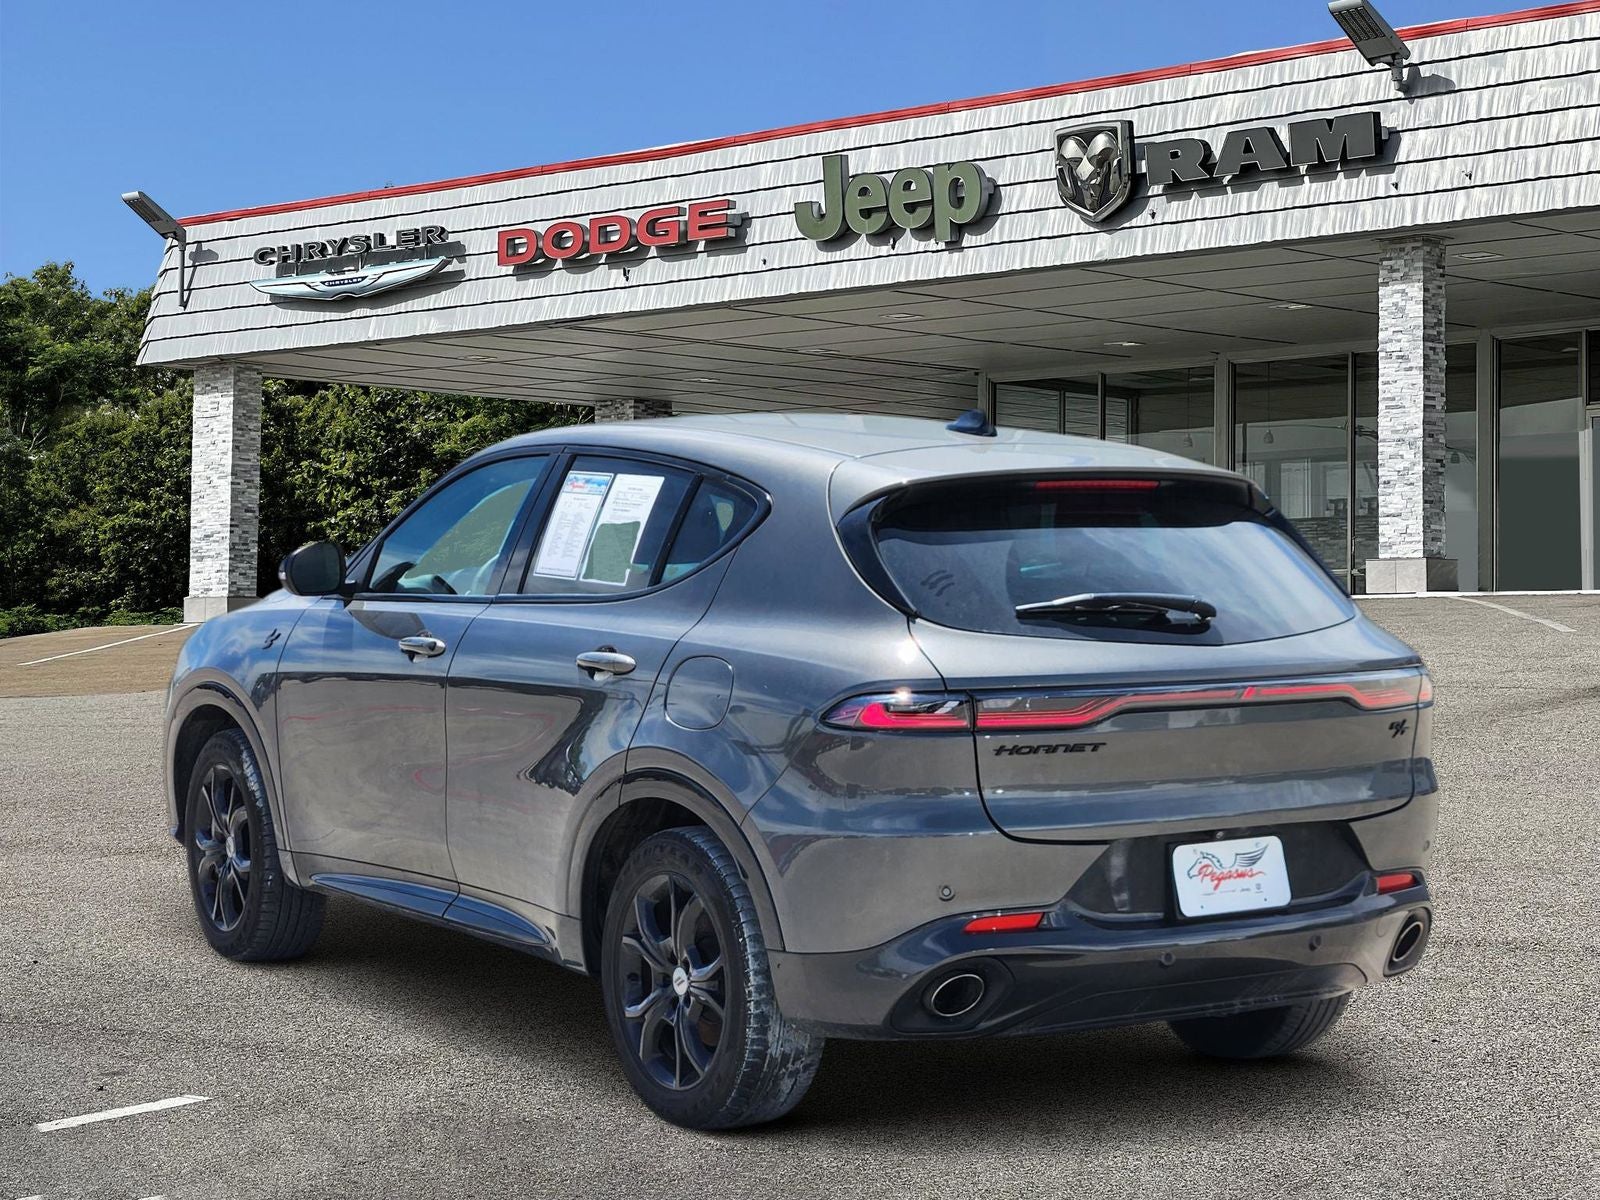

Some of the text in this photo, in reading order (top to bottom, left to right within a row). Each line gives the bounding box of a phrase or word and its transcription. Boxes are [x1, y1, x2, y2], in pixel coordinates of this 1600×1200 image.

[1145, 111, 1381, 187] RAM
[795, 154, 992, 243] Jeep
[253, 225, 448, 266] CHRYSLER
[497, 199, 736, 268] DODGE
[324, 277, 363, 287] CHRYSLER
[993, 742, 1107, 756] HORNET
[1198, 864, 1265, 891] Pegasus
